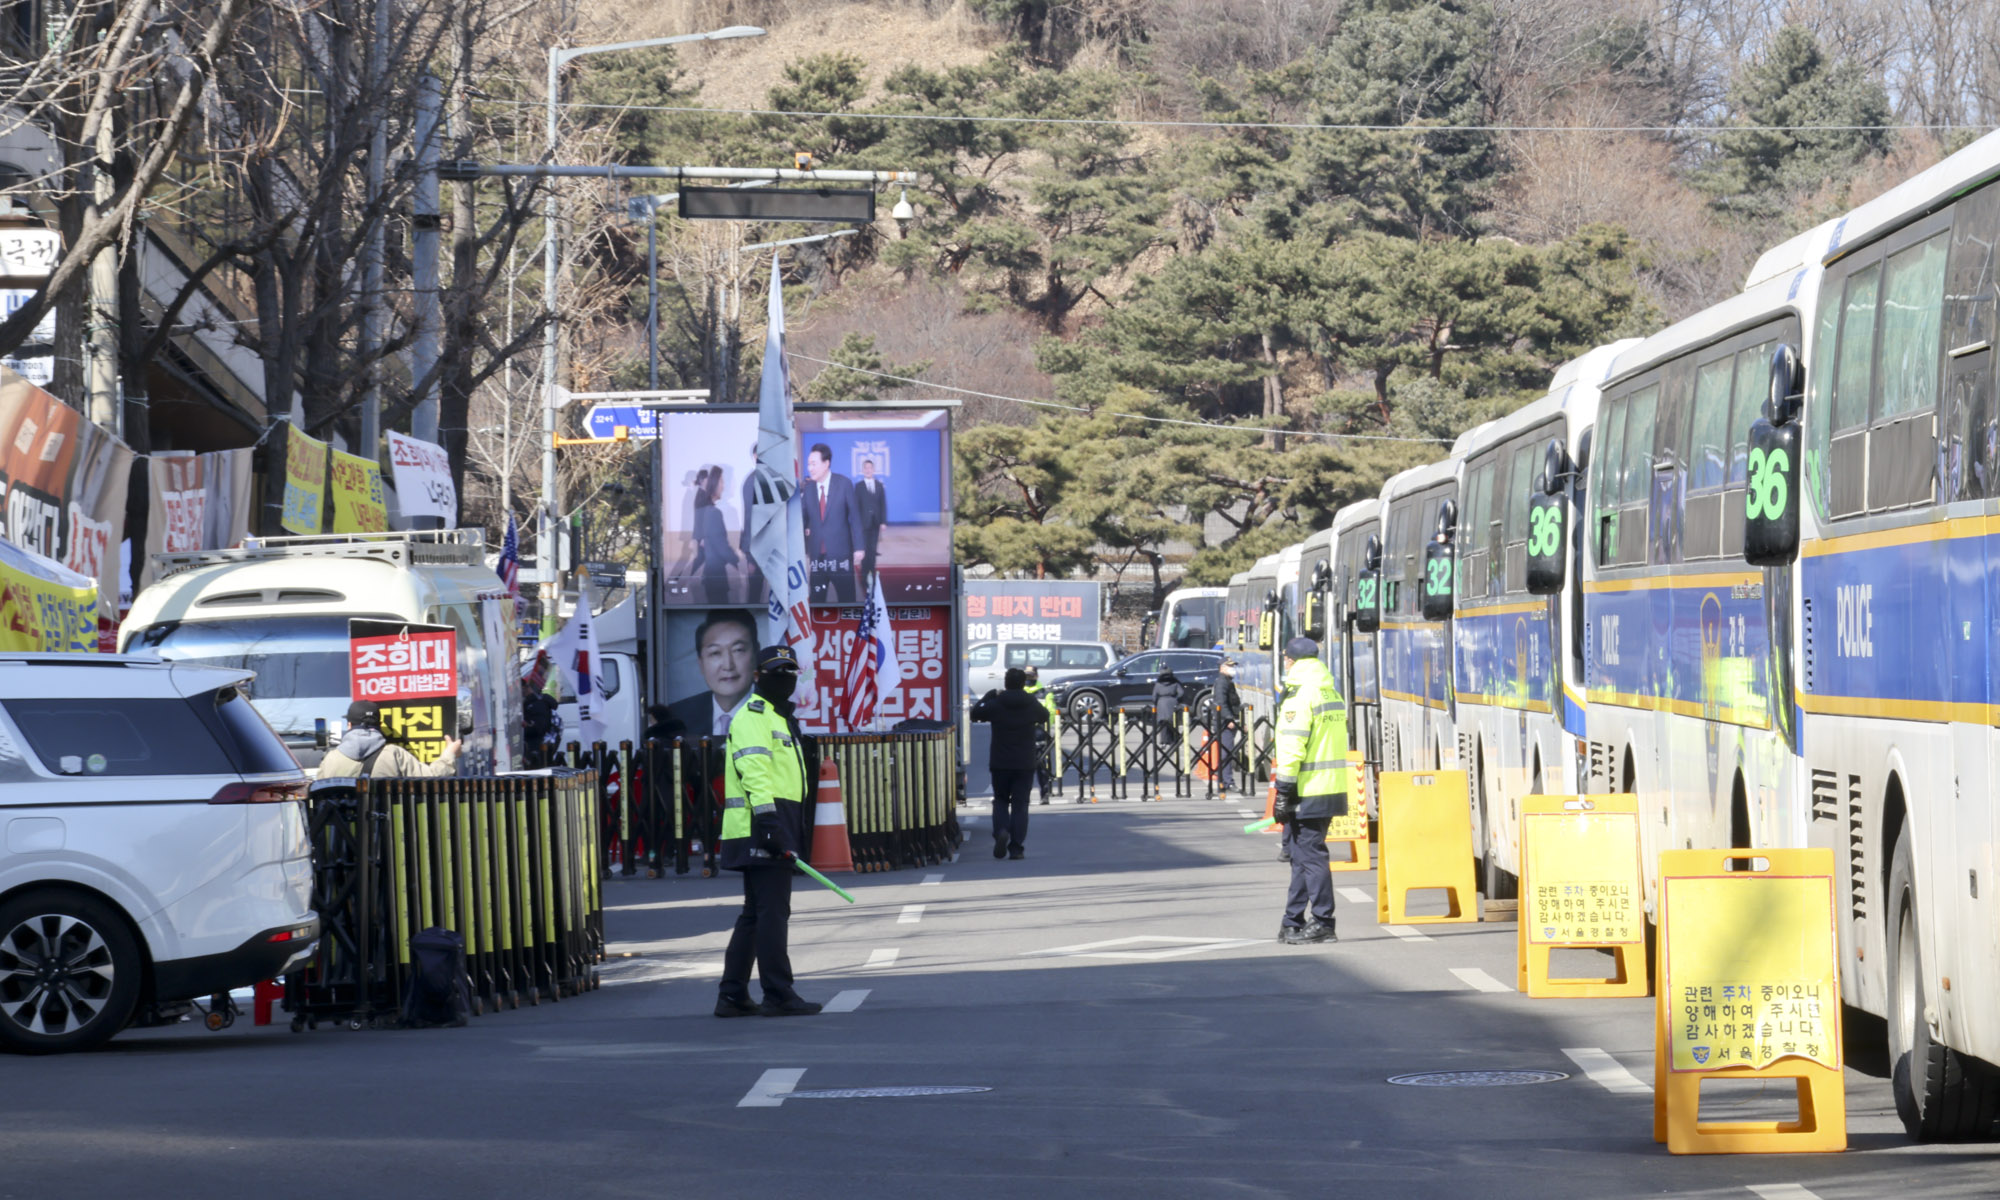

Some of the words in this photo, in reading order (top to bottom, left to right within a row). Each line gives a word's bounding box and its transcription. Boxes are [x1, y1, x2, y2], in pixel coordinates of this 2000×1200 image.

[0, 239, 55, 269] 극권
[1747, 448, 1789, 520] 36
[1528, 506, 1562, 557] 36
[1357, 578, 1377, 610] 32
[1426, 558, 1451, 596] 32
[992, 596, 1034, 617] 폐지
[1040, 596, 1082, 617] 반대
[1837, 584, 1873, 658] POLICE
[355, 639, 450, 675] 조희대
[356, 676, 397, 696] 10명
[400, 673, 451, 693] 대법관
